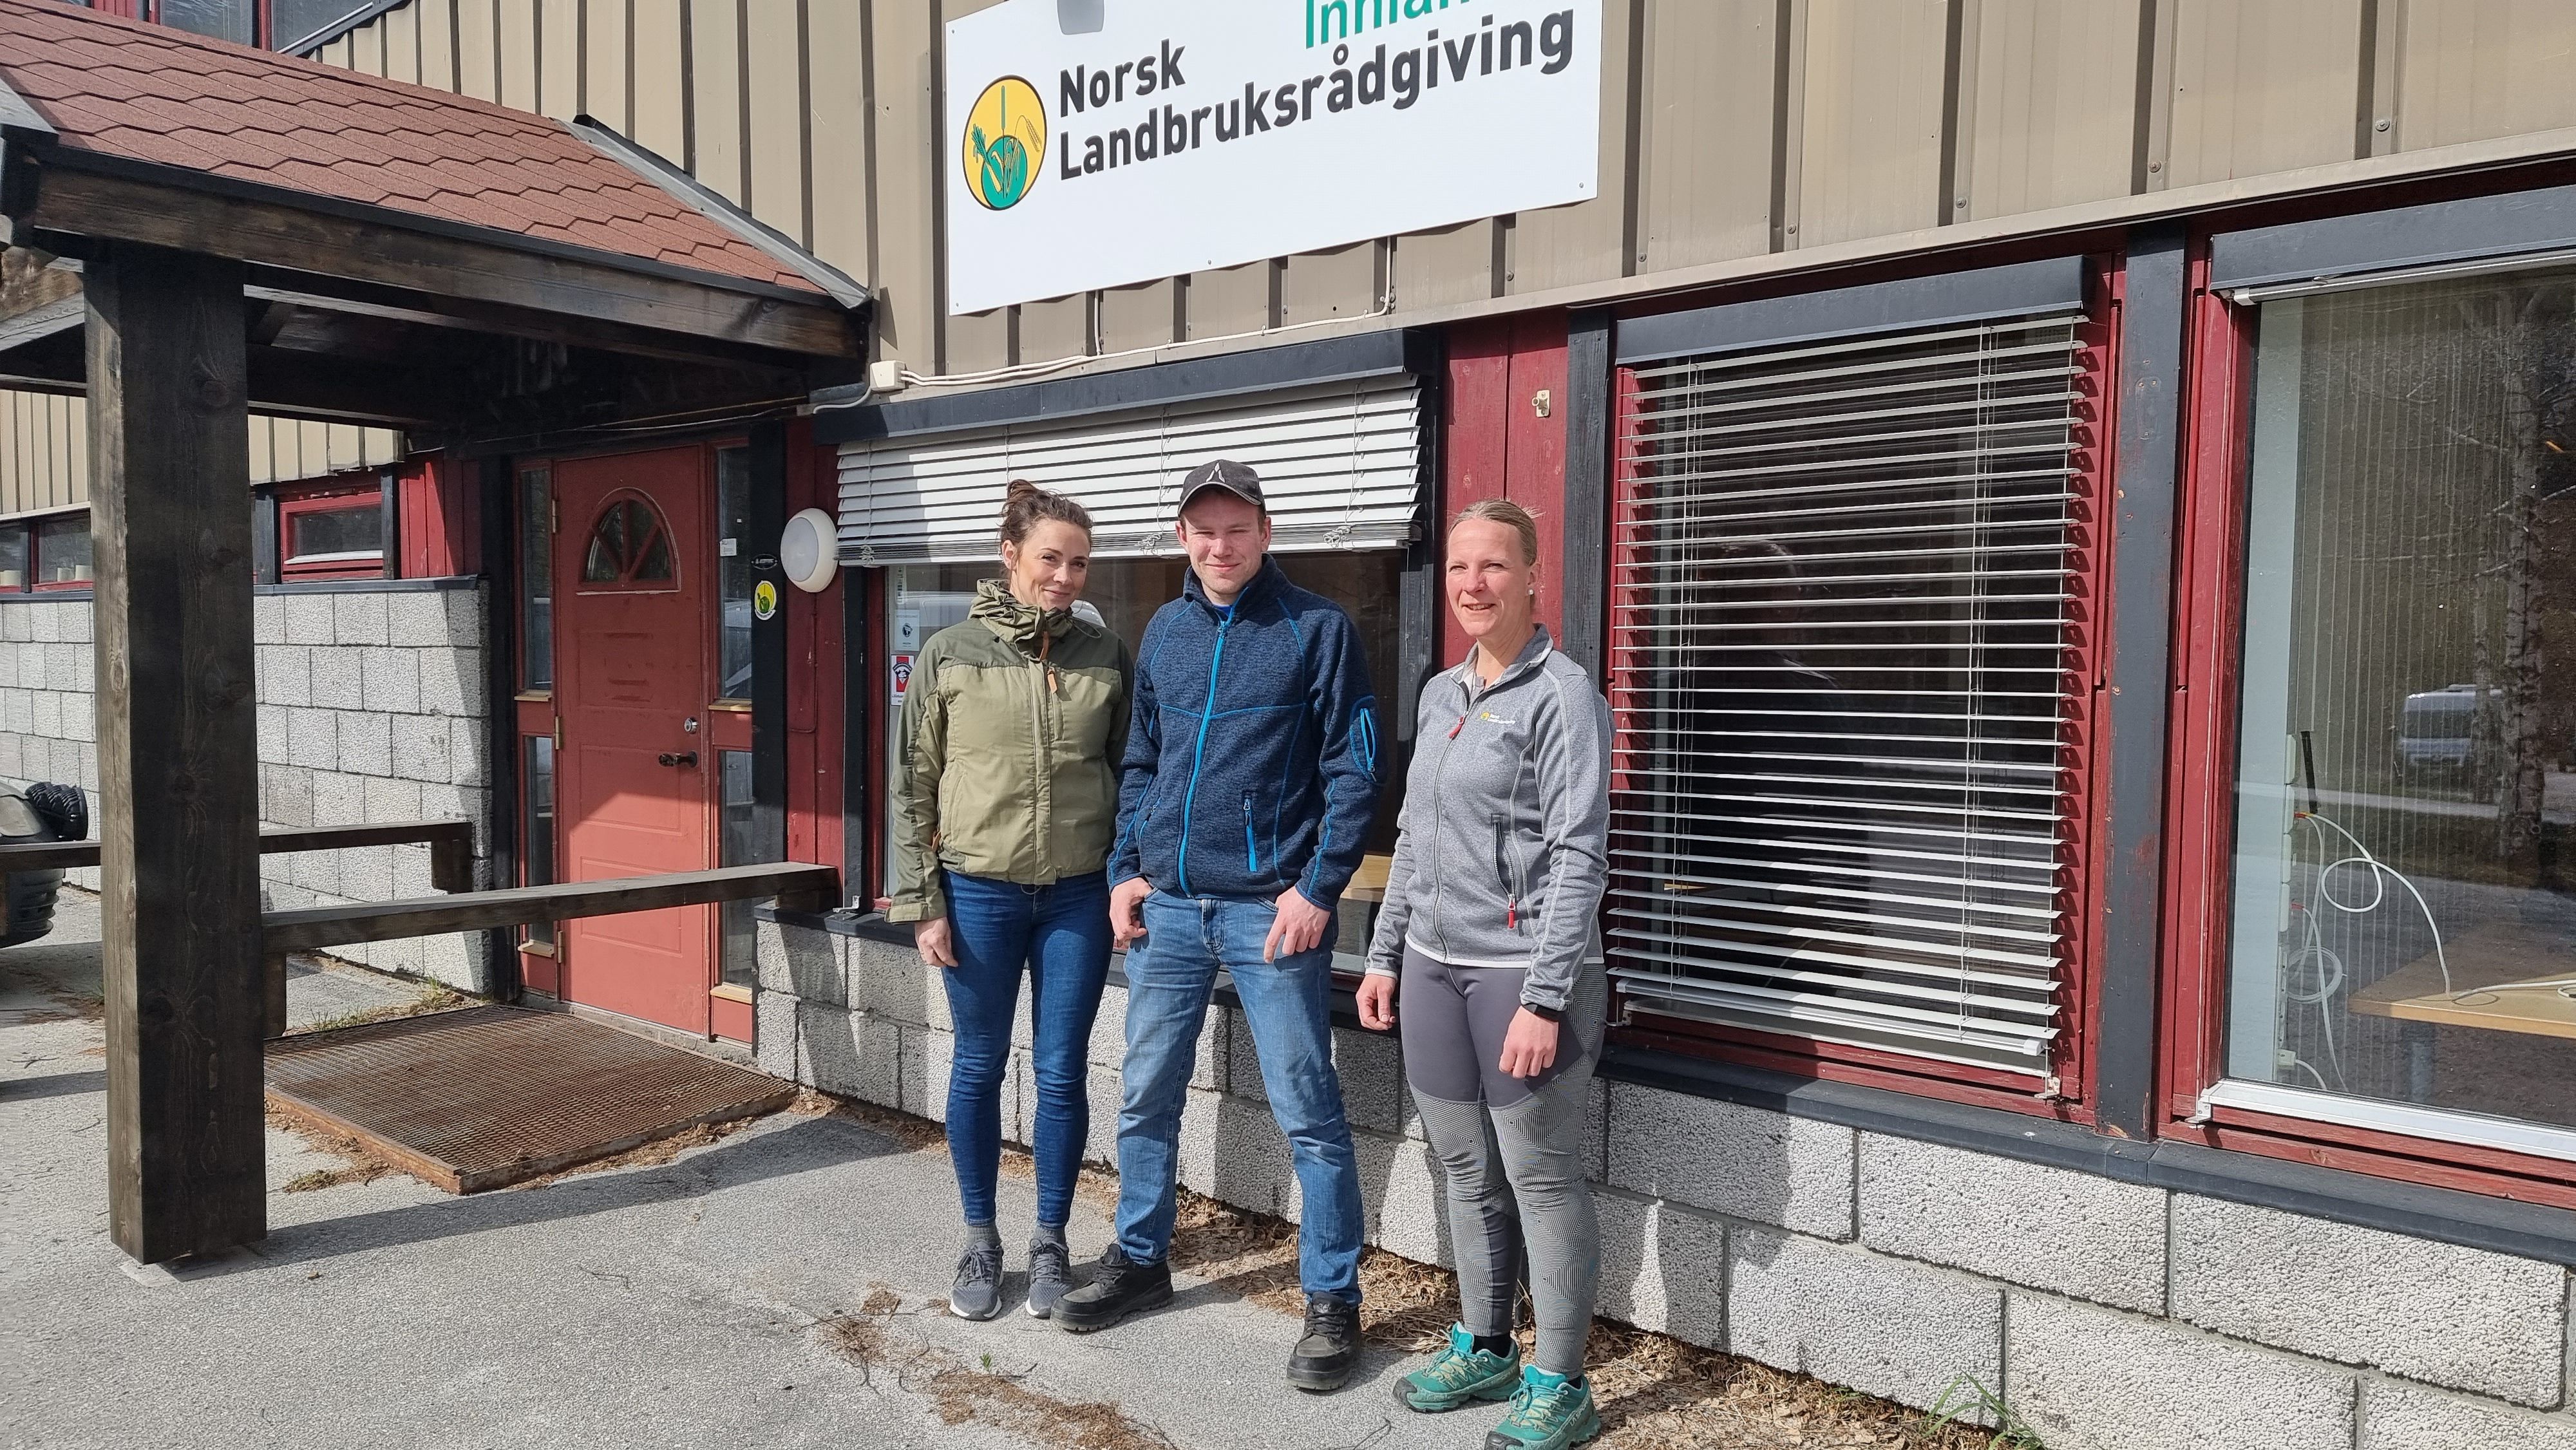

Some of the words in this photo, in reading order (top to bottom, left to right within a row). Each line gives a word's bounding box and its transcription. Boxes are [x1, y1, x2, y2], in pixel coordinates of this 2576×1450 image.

[1306, 0, 1470, 49] Inn
[1060, 39, 1186, 118] Norsk
[1060, 8, 1574, 181] Landbruksrådgiving
